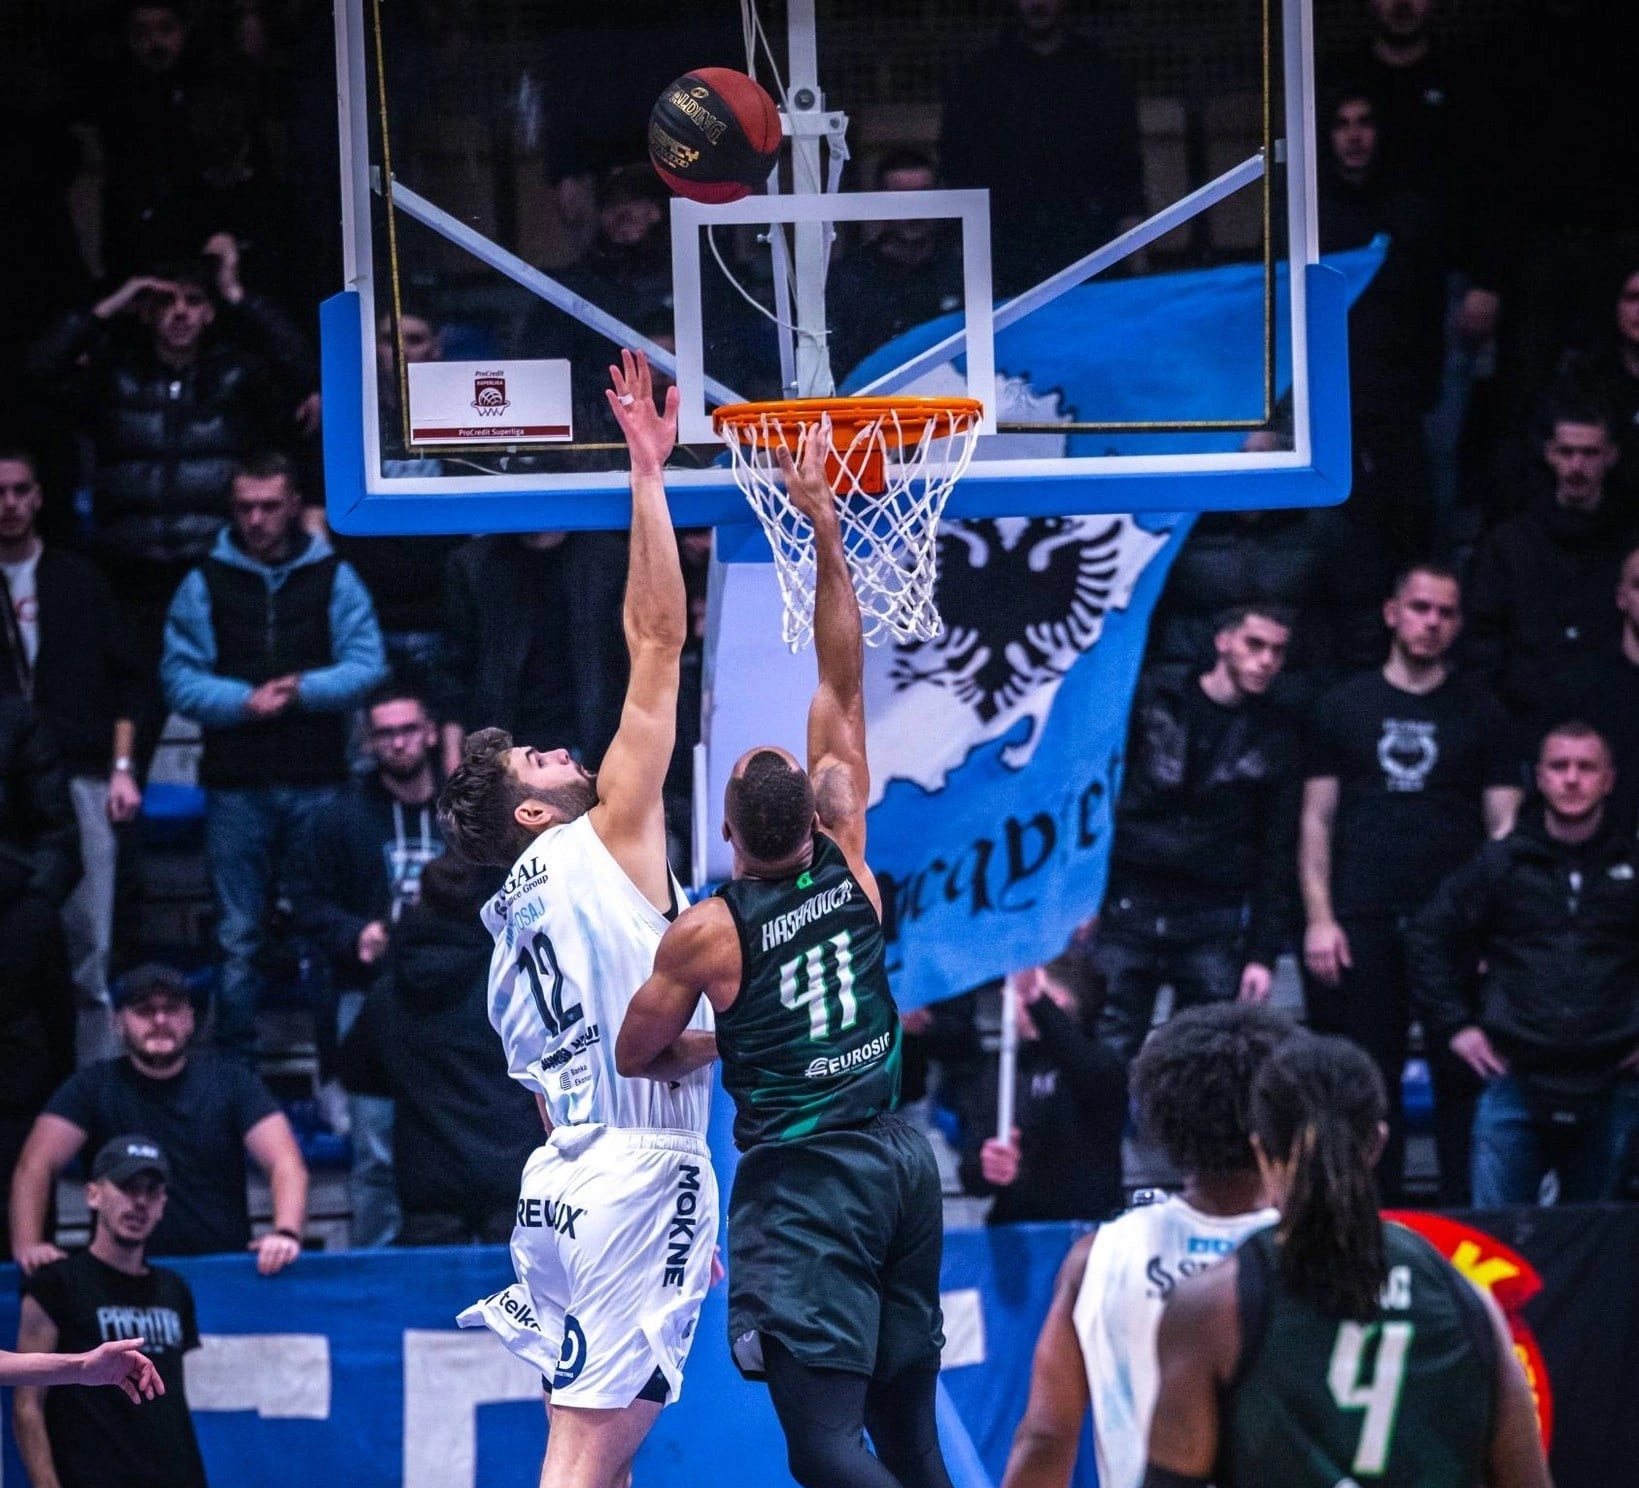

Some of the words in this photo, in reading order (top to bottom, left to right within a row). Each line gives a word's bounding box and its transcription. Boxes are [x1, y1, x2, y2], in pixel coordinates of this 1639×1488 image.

[458, 428, 490, 436] ProCredit
[491, 428, 524, 436] Superliga
[522, 874, 549, 894] Group
[516, 932, 583, 1038] 12
[780, 929, 857, 1041] 41
[662, 1164, 700, 1288] MOKNE
[1328, 1321, 1413, 1475] 4
